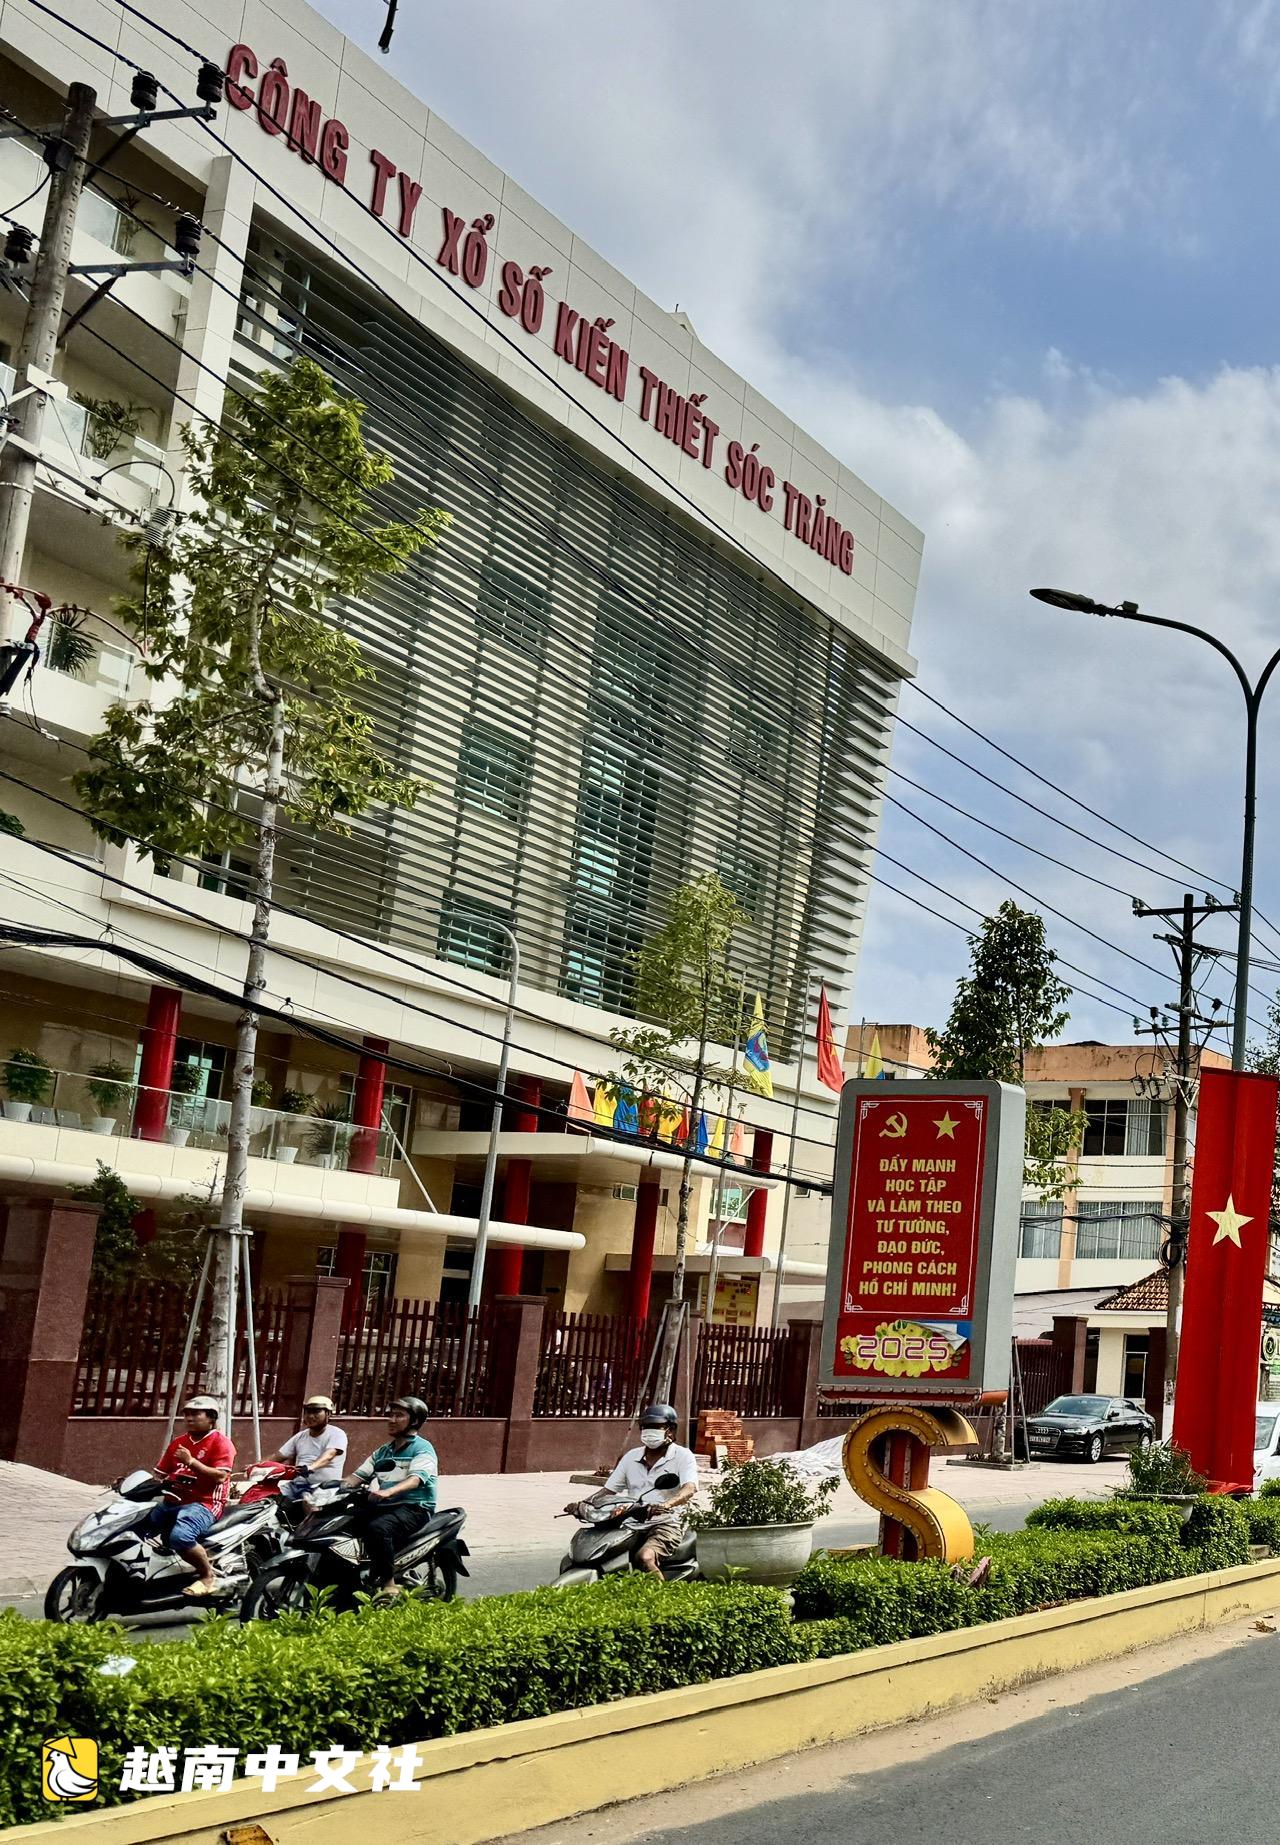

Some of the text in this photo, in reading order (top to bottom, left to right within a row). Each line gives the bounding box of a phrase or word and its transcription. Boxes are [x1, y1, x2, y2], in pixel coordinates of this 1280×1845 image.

[225, 44, 855, 575] CÔNG TY XỔ SỐ KIẾN THIẾT SÓC TRĂNG
[912, 1159, 956, 1175] MẠNH
[885, 1177, 947, 1195] HỌC TẬP
[867, 1197, 962, 1213] VÀ LÀM THEO
[876, 1216, 950, 1236] TƯ TƯỞNG,
[877, 1238, 945, 1256] ĐẠO ĐỨC,
[863, 1259, 957, 1275] PHONG CÁCH
[883, 1279, 908, 1296] CHÍ
[912, 1282, 957, 1297] MINH!
[857, 1335, 949, 1361] 2025
